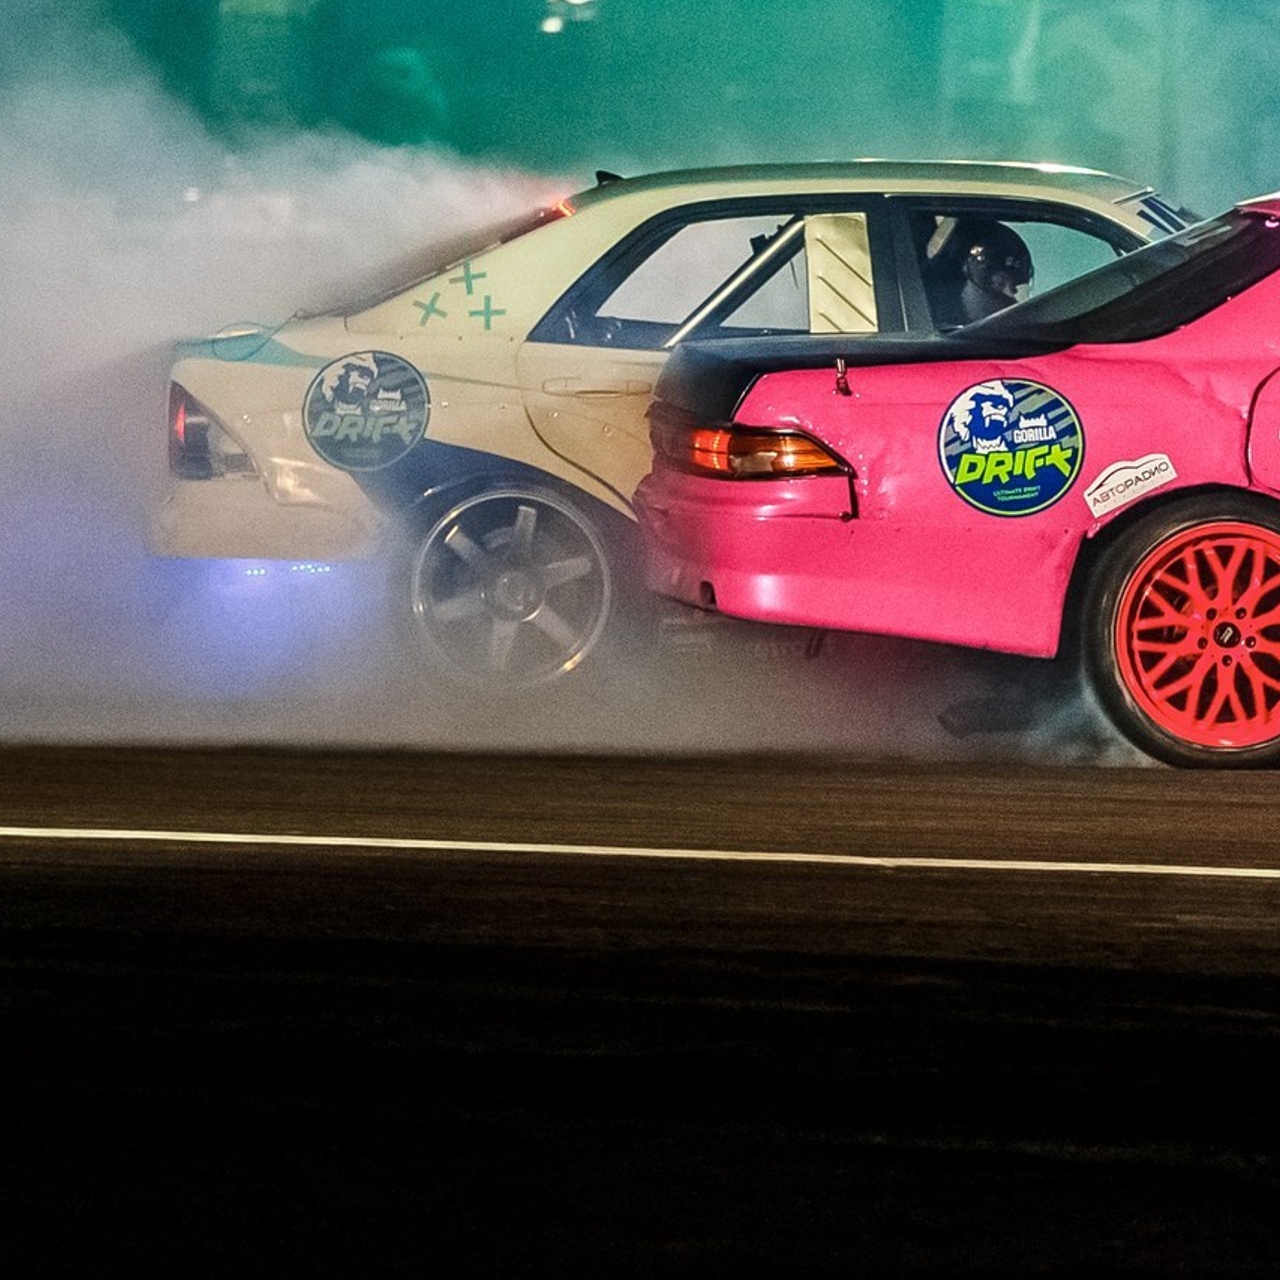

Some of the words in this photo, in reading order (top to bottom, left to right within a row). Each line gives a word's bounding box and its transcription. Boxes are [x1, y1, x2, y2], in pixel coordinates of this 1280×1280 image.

[310, 412, 418, 445] DRIFT
[1013, 425, 1057, 444] GORILLA
[955, 444, 1073, 484] DRIFT
[1092, 461, 1170, 507] АВТОРАДИО
